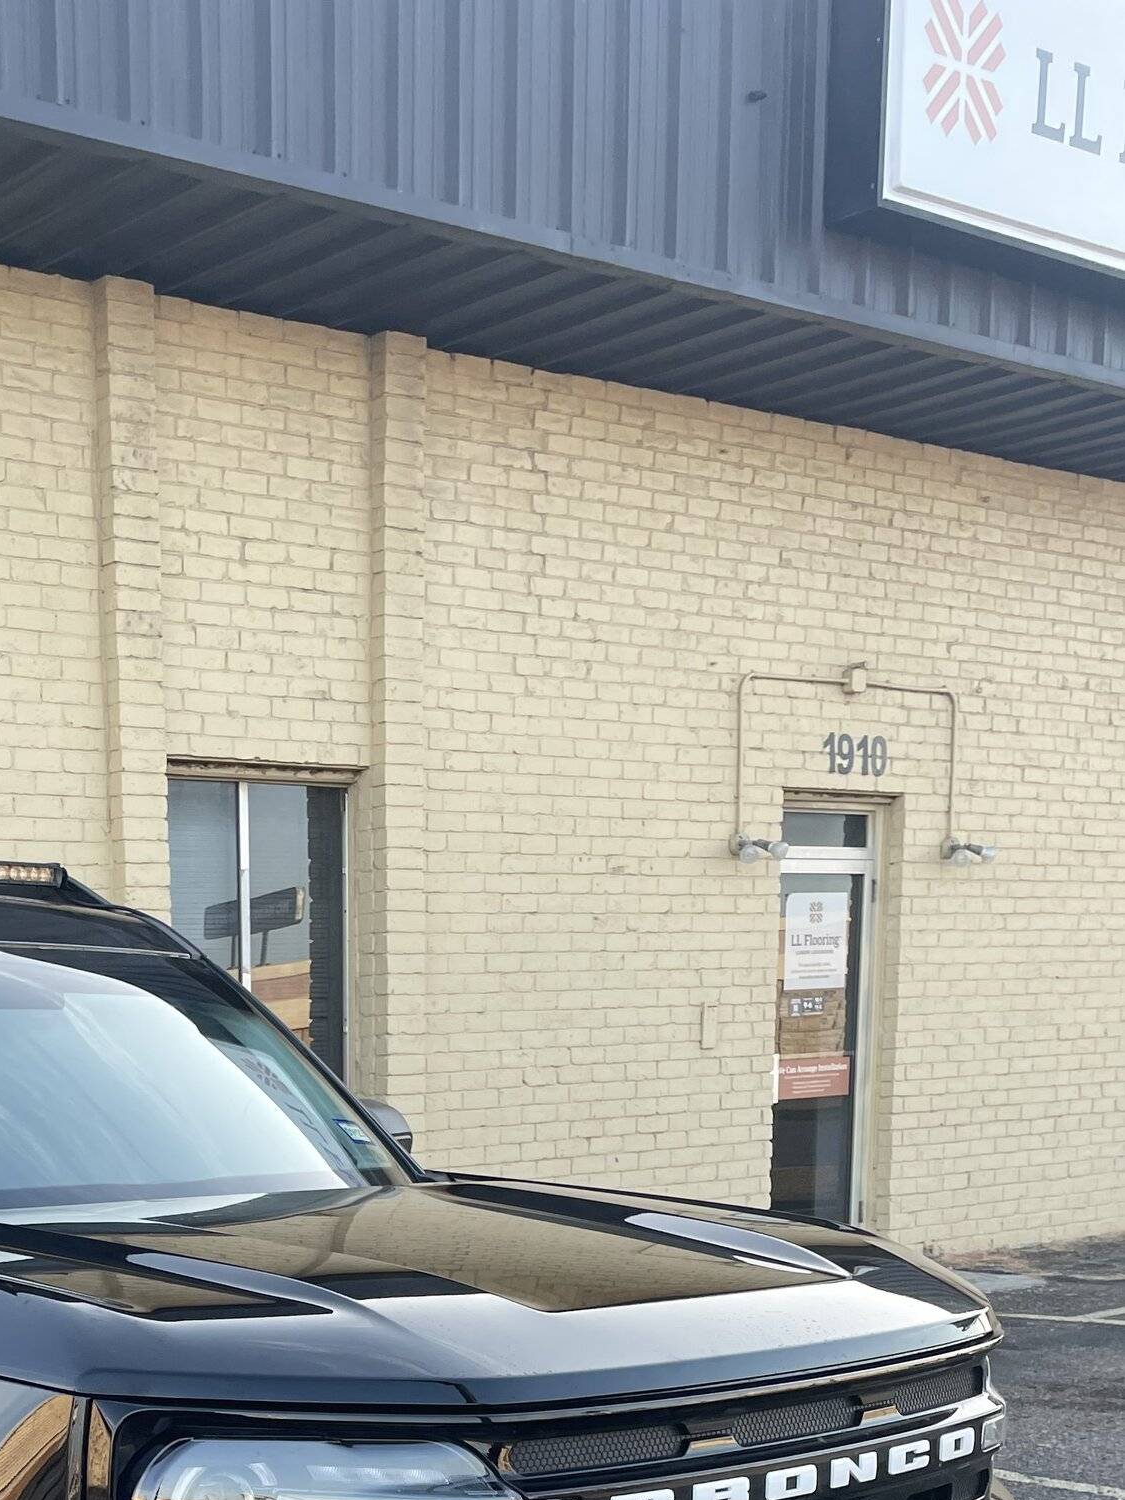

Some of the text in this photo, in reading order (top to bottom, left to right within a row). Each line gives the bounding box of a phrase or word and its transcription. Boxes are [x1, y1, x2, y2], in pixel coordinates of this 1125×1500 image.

[1031, 47, 1103, 156] LL
[822, 732, 887, 777] 1910
[791, 934, 840, 949] LL Flooring
